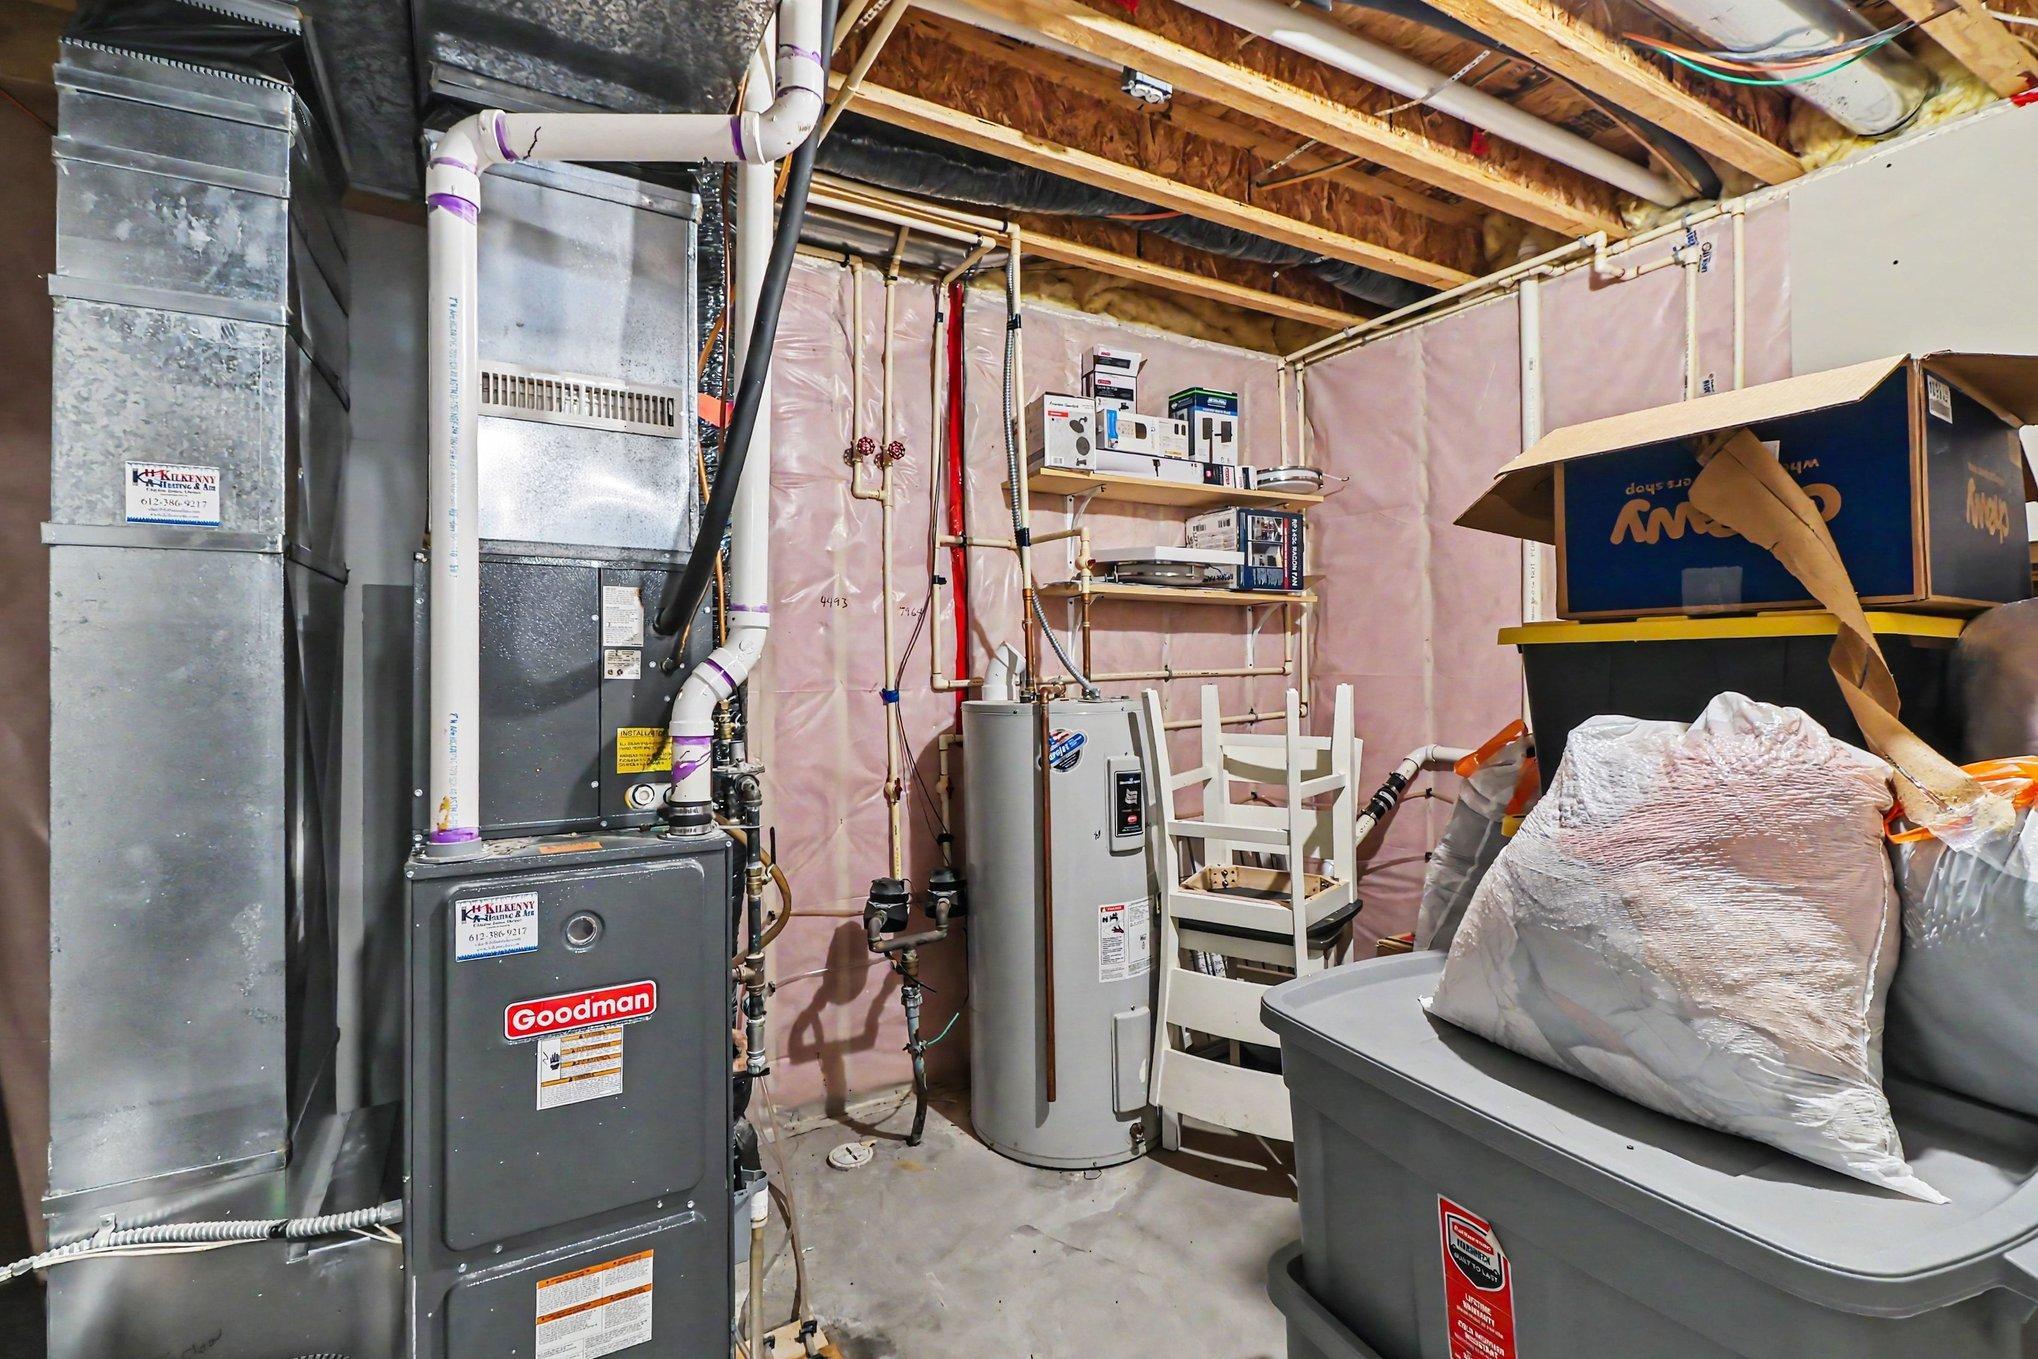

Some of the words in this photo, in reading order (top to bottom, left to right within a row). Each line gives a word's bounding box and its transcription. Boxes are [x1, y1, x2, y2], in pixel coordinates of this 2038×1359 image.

[160, 469, 216, 484] KILKENNY
[1666, 477, 1692, 489] ers
[193, 482, 201, 490] &
[1625, 481, 1664, 496] shop
[140, 497, 207, 508] 612-386-9217
[485, 901, 535, 914] KILKENNY
[468, 927, 527, 942] 612-386-9217
[512, 992, 650, 1031] Goodman
[1471, 1264, 1481, 1273] TO
[1481, 1268, 1498, 1283] LAST
